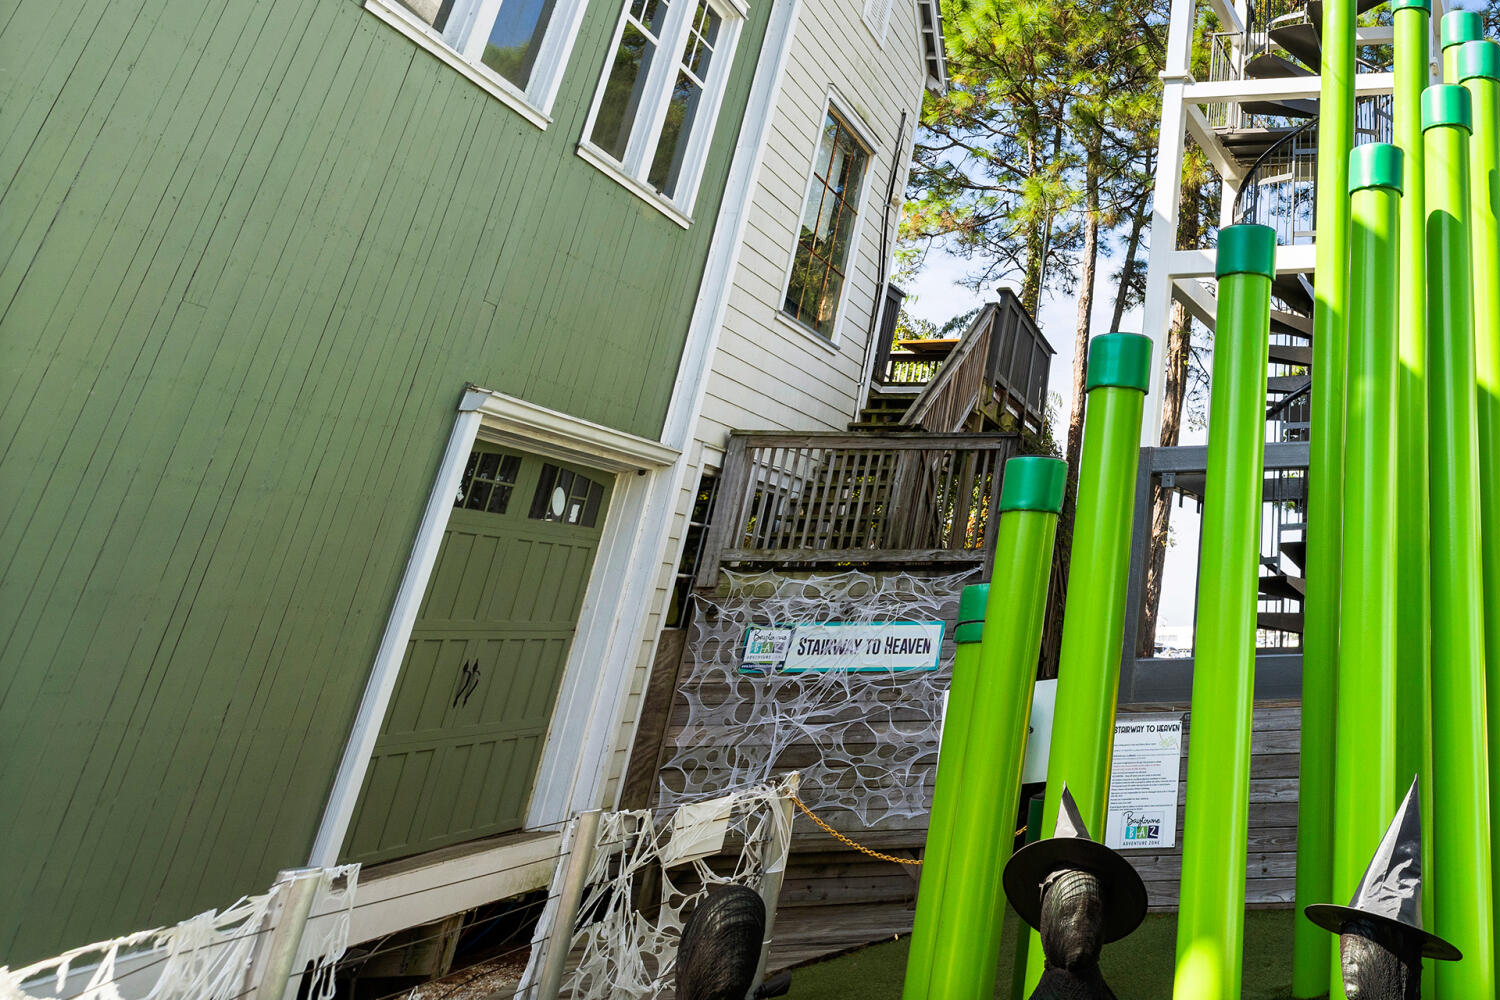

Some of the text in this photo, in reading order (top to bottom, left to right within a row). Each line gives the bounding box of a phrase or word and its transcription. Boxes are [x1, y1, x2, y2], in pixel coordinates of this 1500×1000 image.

[797, 636, 863, 656] STAIRWAY
[884, 636, 931, 655] HEAVEN
[1114, 724, 1180, 734] STAIRWAY TO HEAVEN
[1122, 811, 1161, 828] Baytowne
[1125, 825, 1160, 839] BAZ
